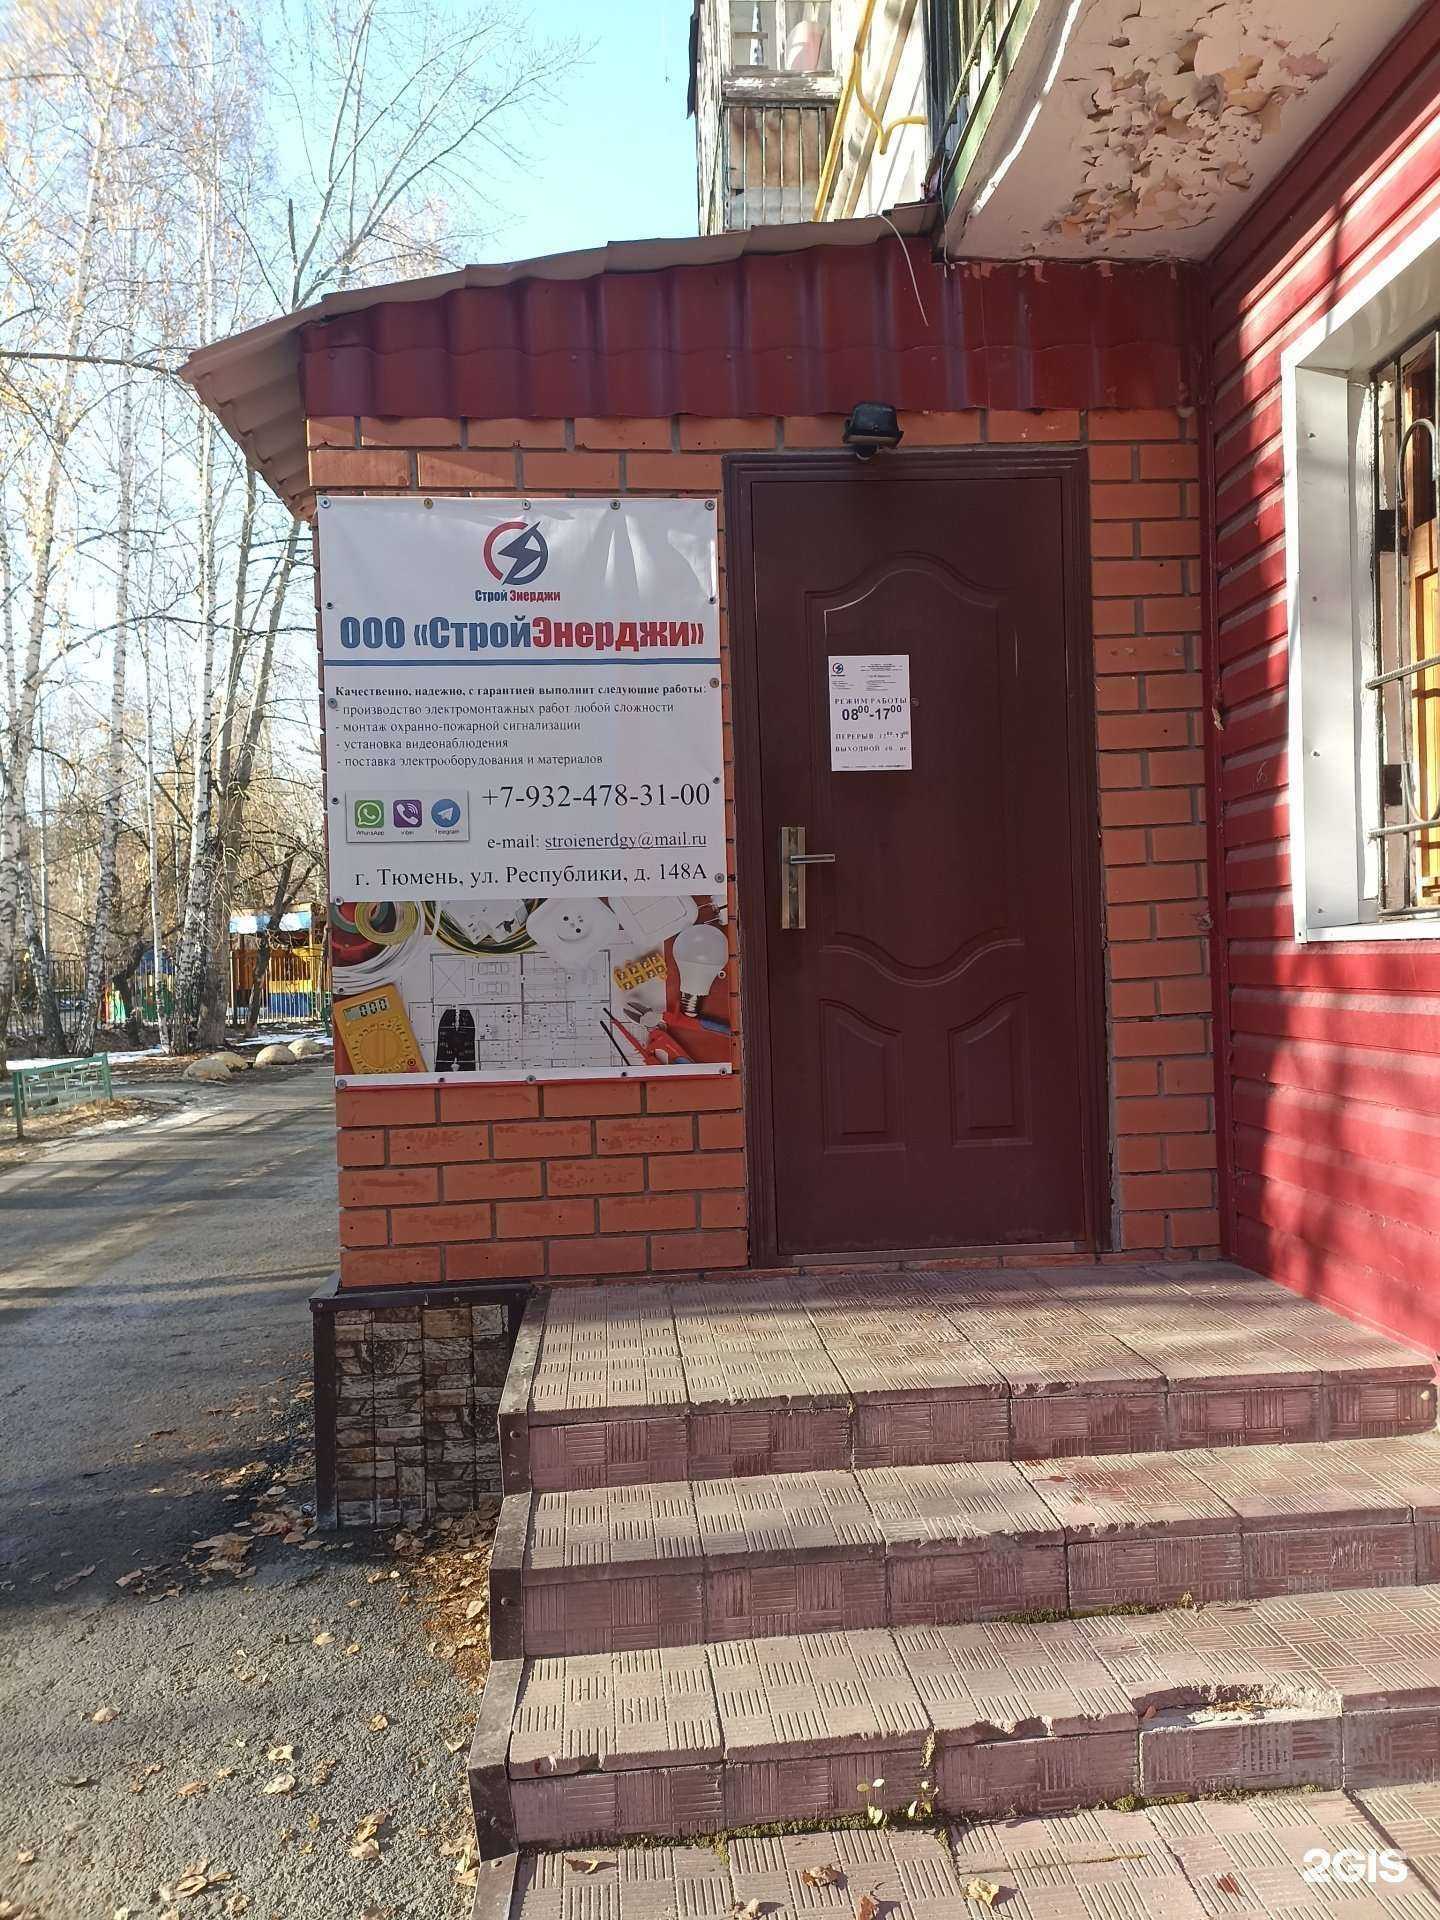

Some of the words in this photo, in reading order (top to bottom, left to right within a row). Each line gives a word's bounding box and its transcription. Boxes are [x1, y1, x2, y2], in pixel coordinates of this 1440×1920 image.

[475, 589, 508, 602] Строй
[509, 590, 561, 603] Энерджи
[340, 616, 406, 649] ООО
[413, 615, 704, 652] «СтройЭнерджи»
[335, 686, 411, 697] Качественно,
[415, 686, 466, 697] надежно,
[477, 686, 535, 698] гарантией
[538, 685, 595, 697] выполнит
[343, 704, 422, 717] производство
[425, 702, 535, 717] электромонтажных
[539, 701, 570, 715] работ
[574, 701, 612, 713] любой
[614, 702, 674, 713] сложности
[343, 724, 387, 733] монтаж
[390, 720, 500, 735] охранно-пожарной
[502, 721, 581, 732] сигнализации
[344, 741, 402, 752] установка
[405, 738, 508, 750] видеонаблюдения
[345, 758, 397, 768] поставка
[400, 754, 523, 769] электрооборудования
[538, 753, 603, 767] материалов
[482, 783, 711, 808] +7-932-478-31-00
[487, 834, 540, 848] e-mail:
[545, 831, 708, 850] stroienerdgy@mail.ru
[355, 873, 370, 886] г.
[376, 867, 464, 886] Тюмень,
[470, 871, 499, 889] ул.
[506, 864, 628, 887] Республики,
[634, 867, 651, 882] д.
[659, 862, 708, 881] 148А
